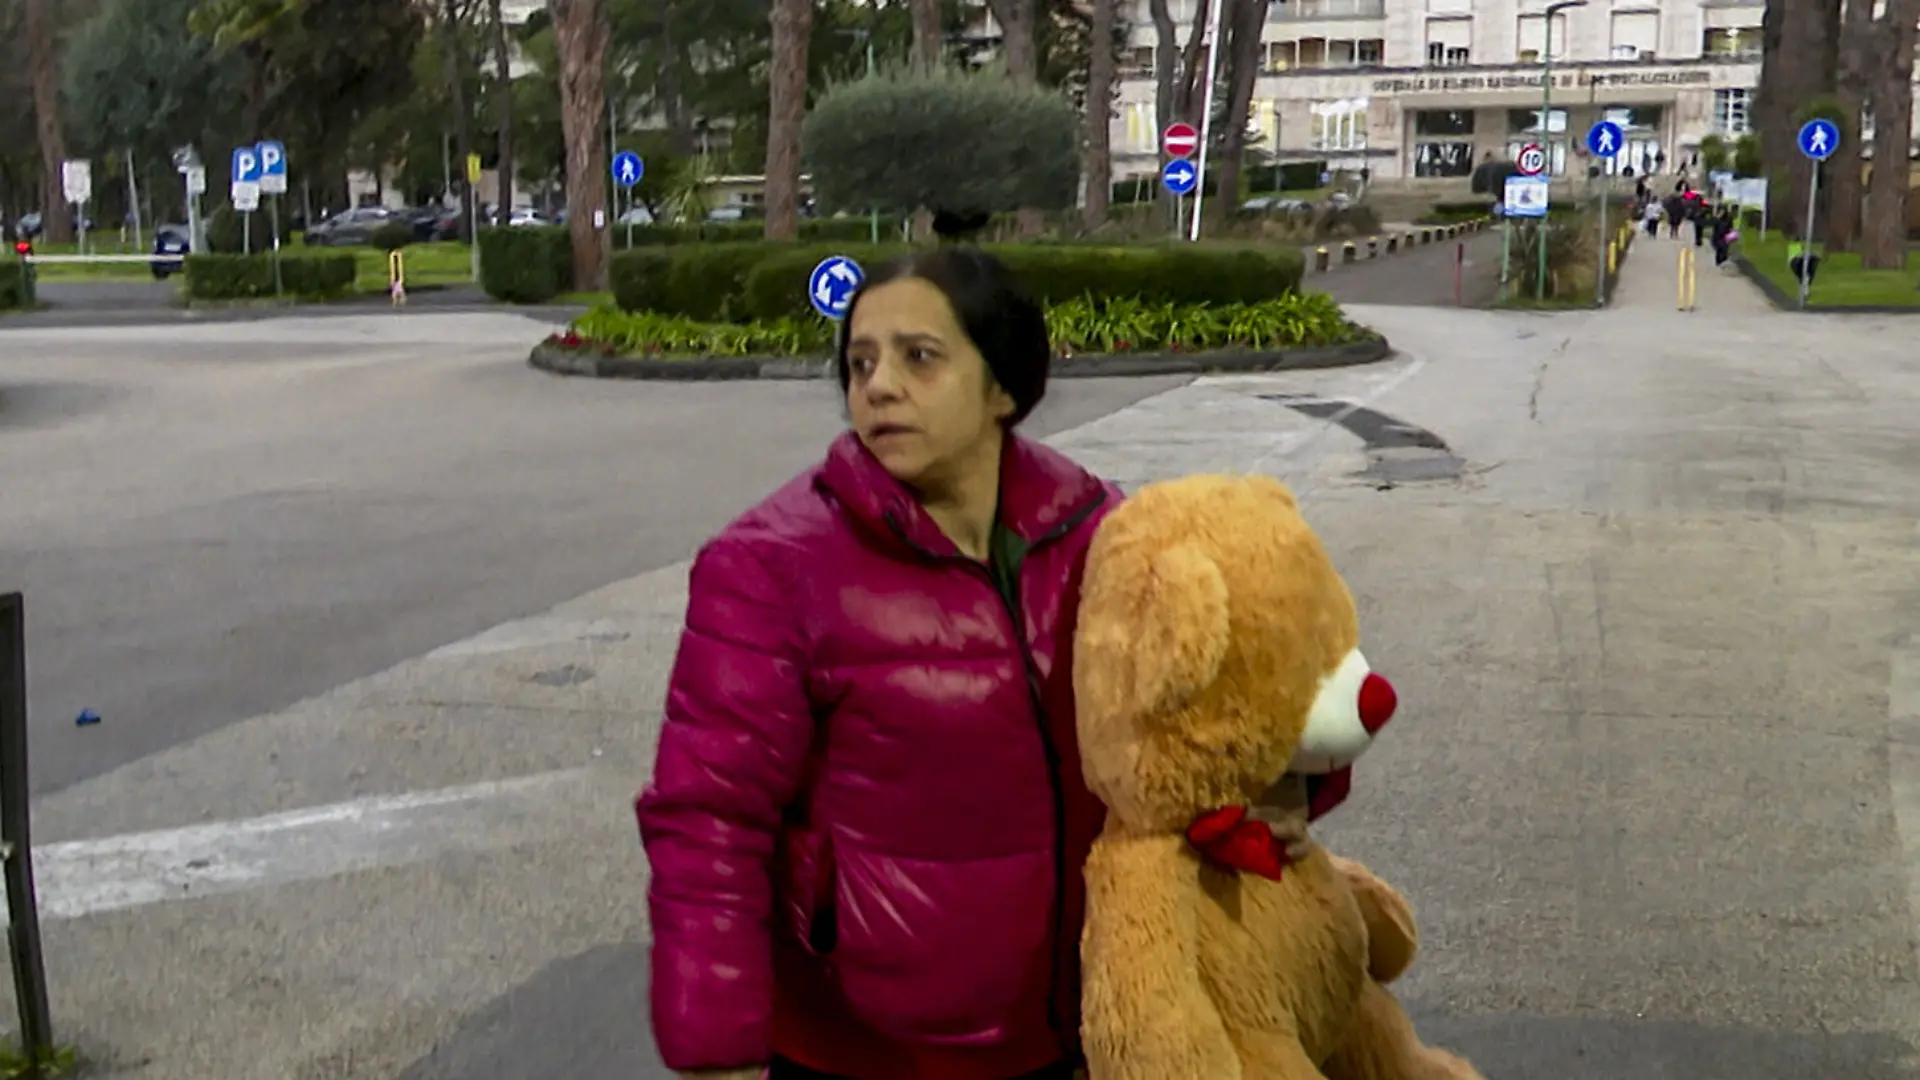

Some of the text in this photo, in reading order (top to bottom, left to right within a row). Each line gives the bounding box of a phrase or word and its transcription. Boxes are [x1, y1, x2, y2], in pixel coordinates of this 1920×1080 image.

[239, 151, 256, 180] P
[262, 144, 280, 173] P
[1525, 153, 1541, 168] 10
